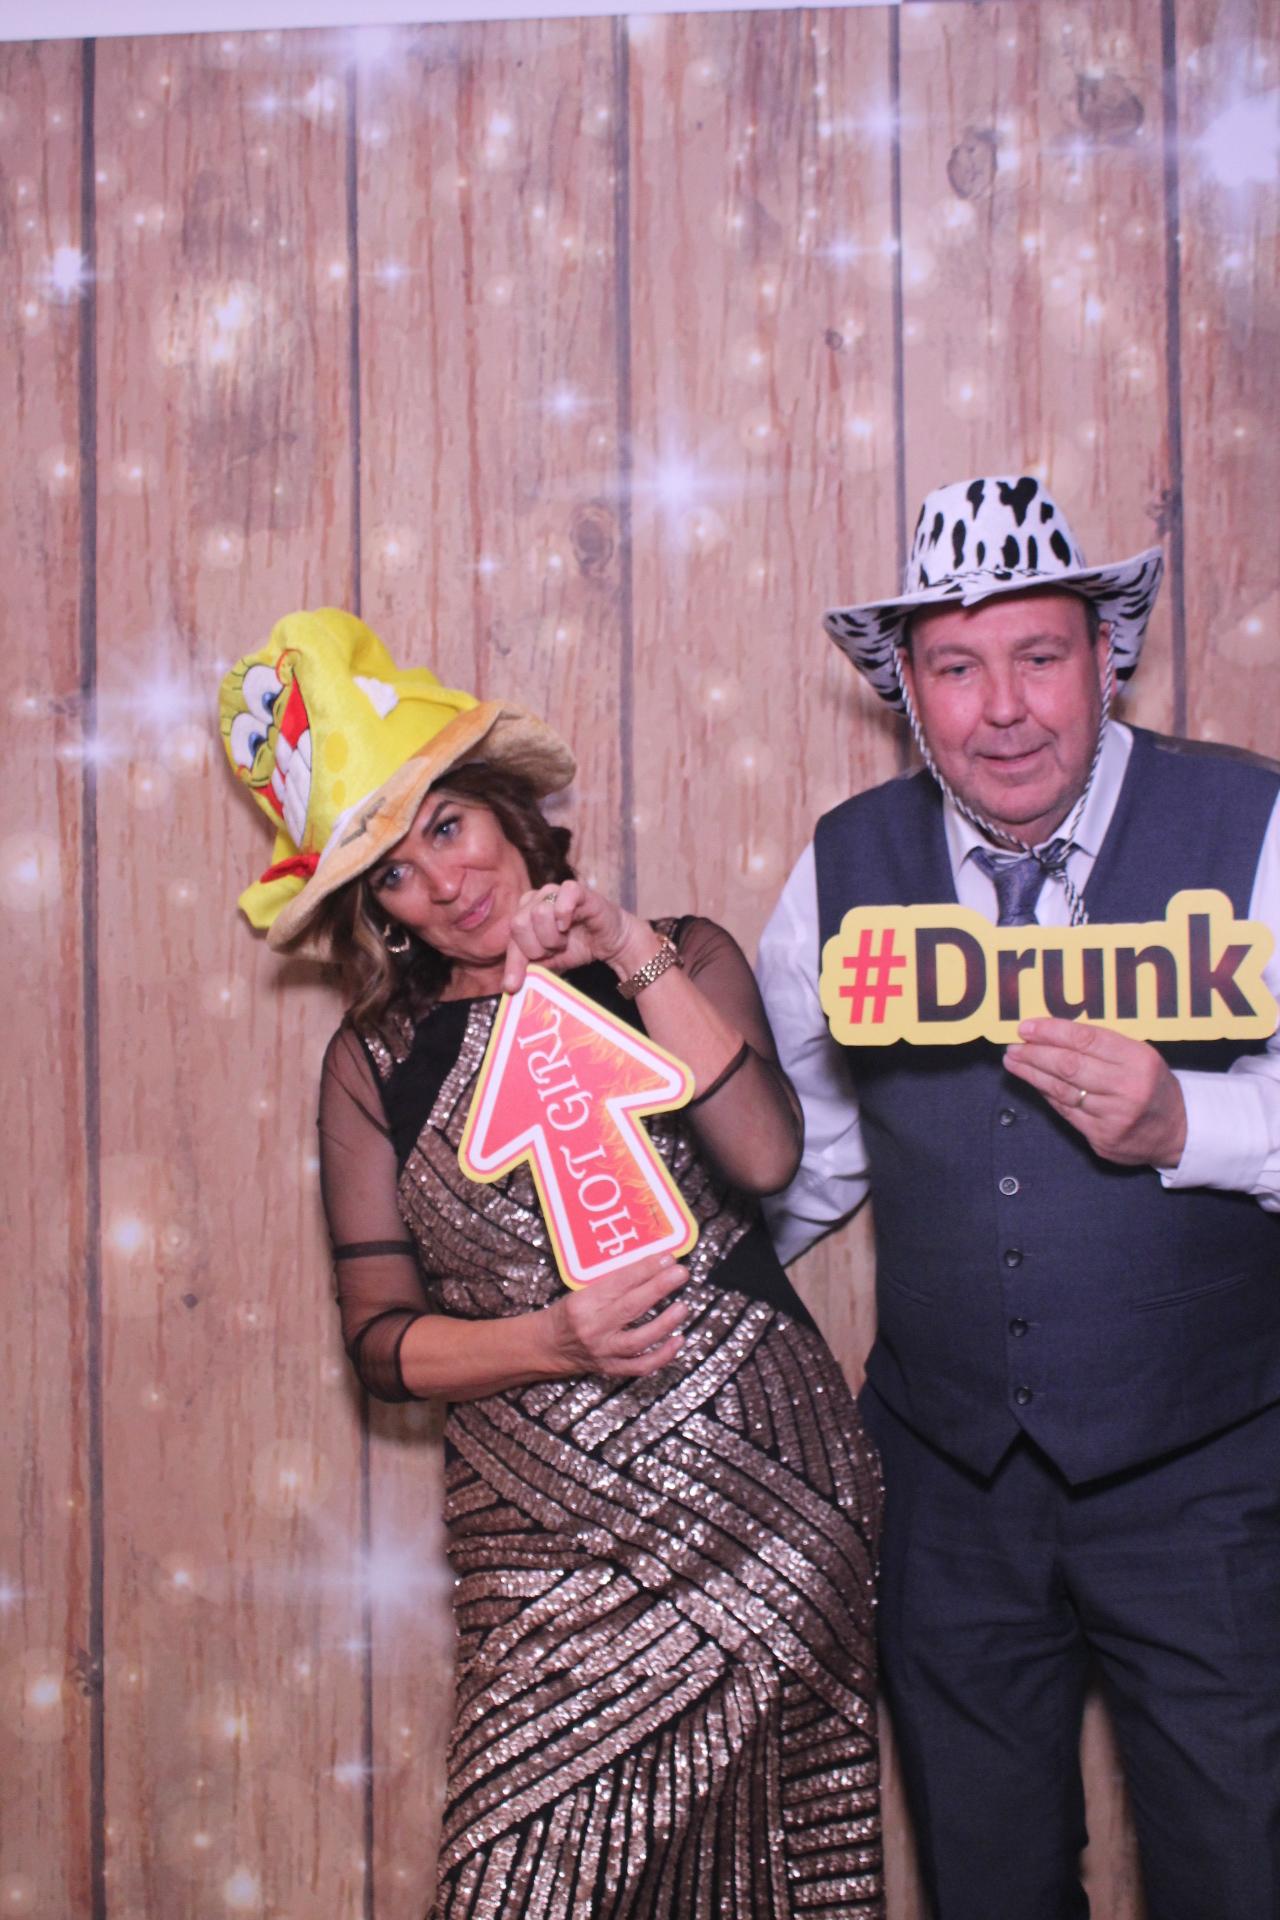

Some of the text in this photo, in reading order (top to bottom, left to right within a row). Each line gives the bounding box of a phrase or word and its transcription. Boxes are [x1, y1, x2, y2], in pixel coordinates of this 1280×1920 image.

[839, 913, 1258, 1024] #Drunk
[517, 1008, 639, 1257] HOT GIRL
